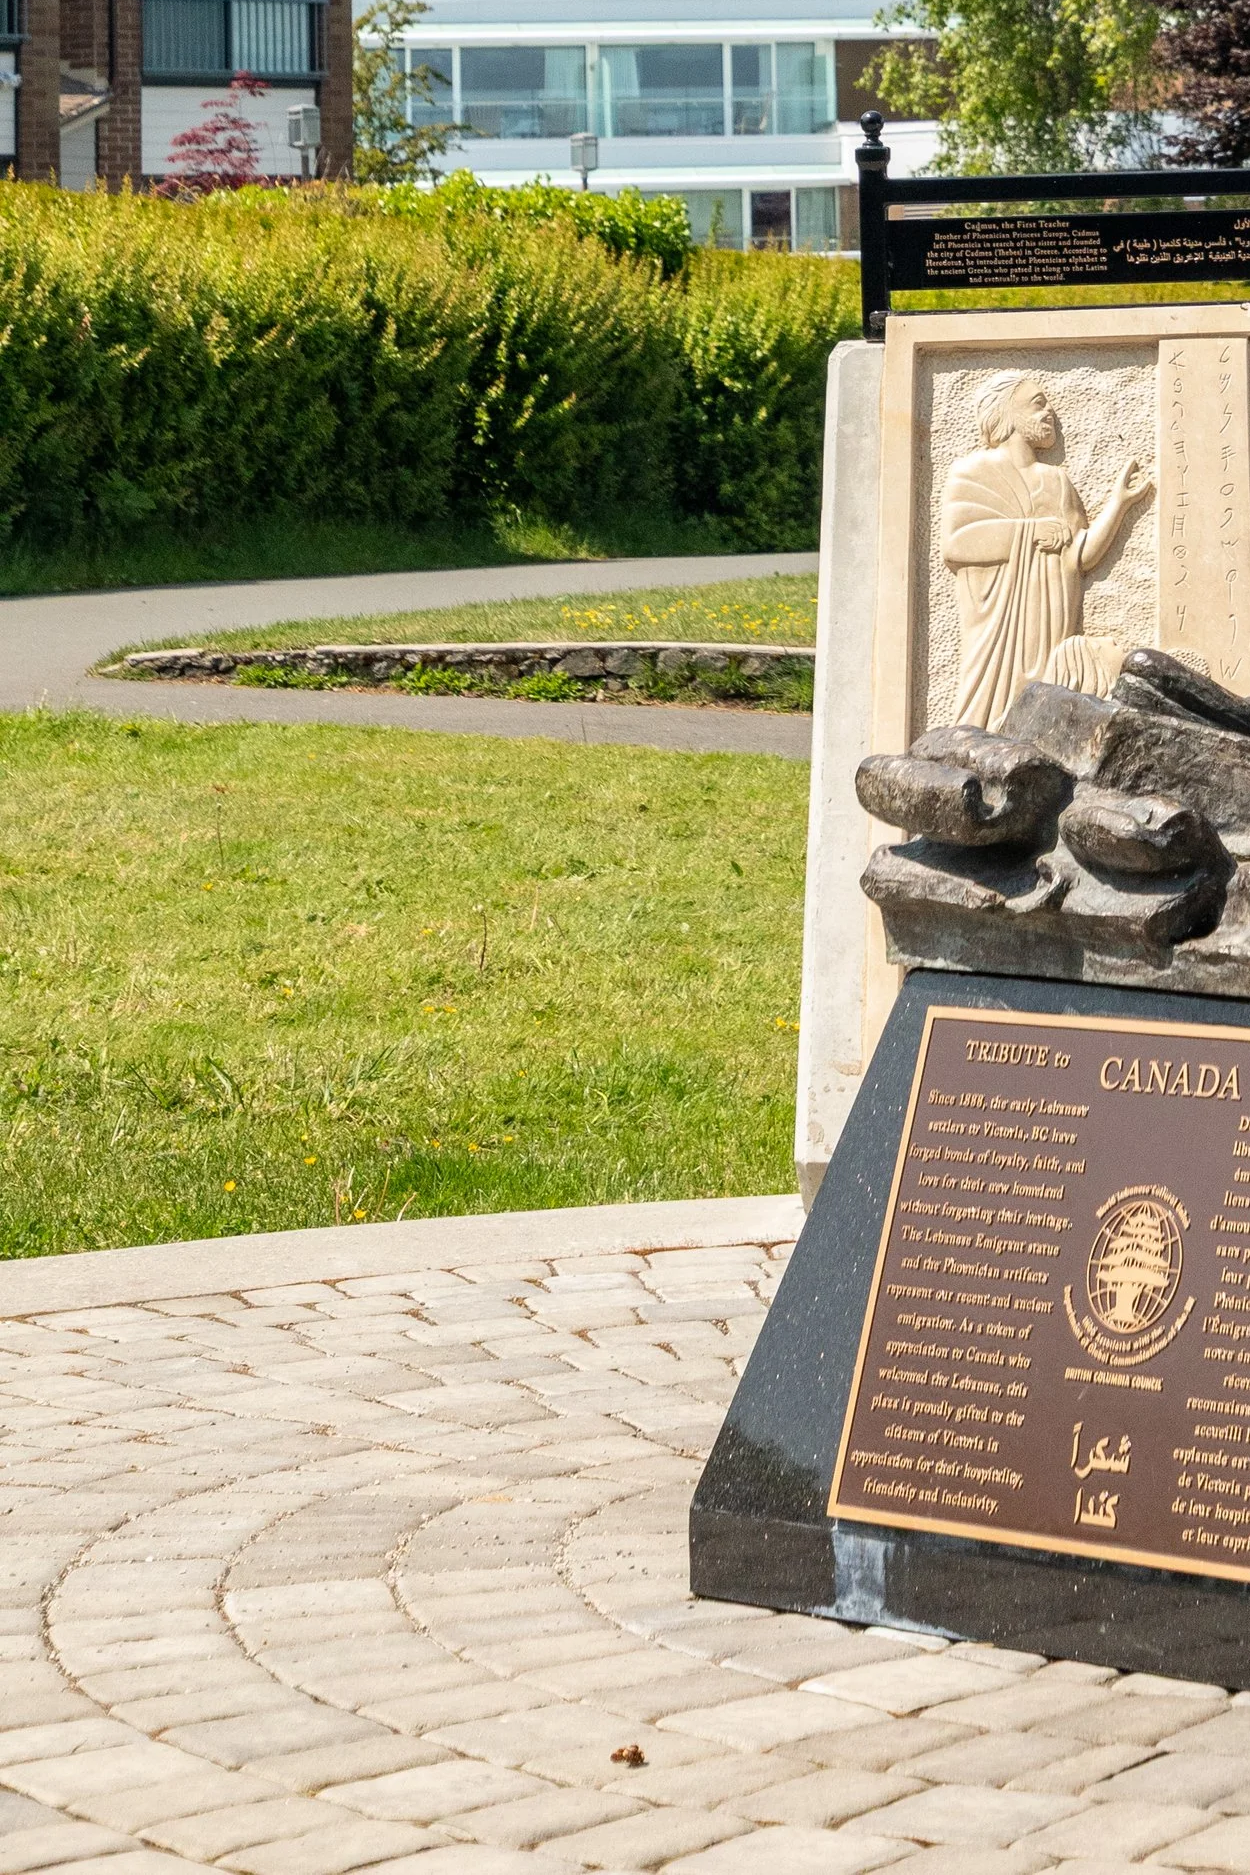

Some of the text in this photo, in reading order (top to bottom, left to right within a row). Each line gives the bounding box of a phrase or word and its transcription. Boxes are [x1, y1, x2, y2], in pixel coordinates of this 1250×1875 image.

[963, 221, 999, 231] Cadmus,
[1016, 220, 1036, 228] First
[1037, 219, 1069, 228] Teacher
[965, 1038, 1071, 1067] TRIBUTE to
[1099, 1056, 1240, 1099] CANADA
